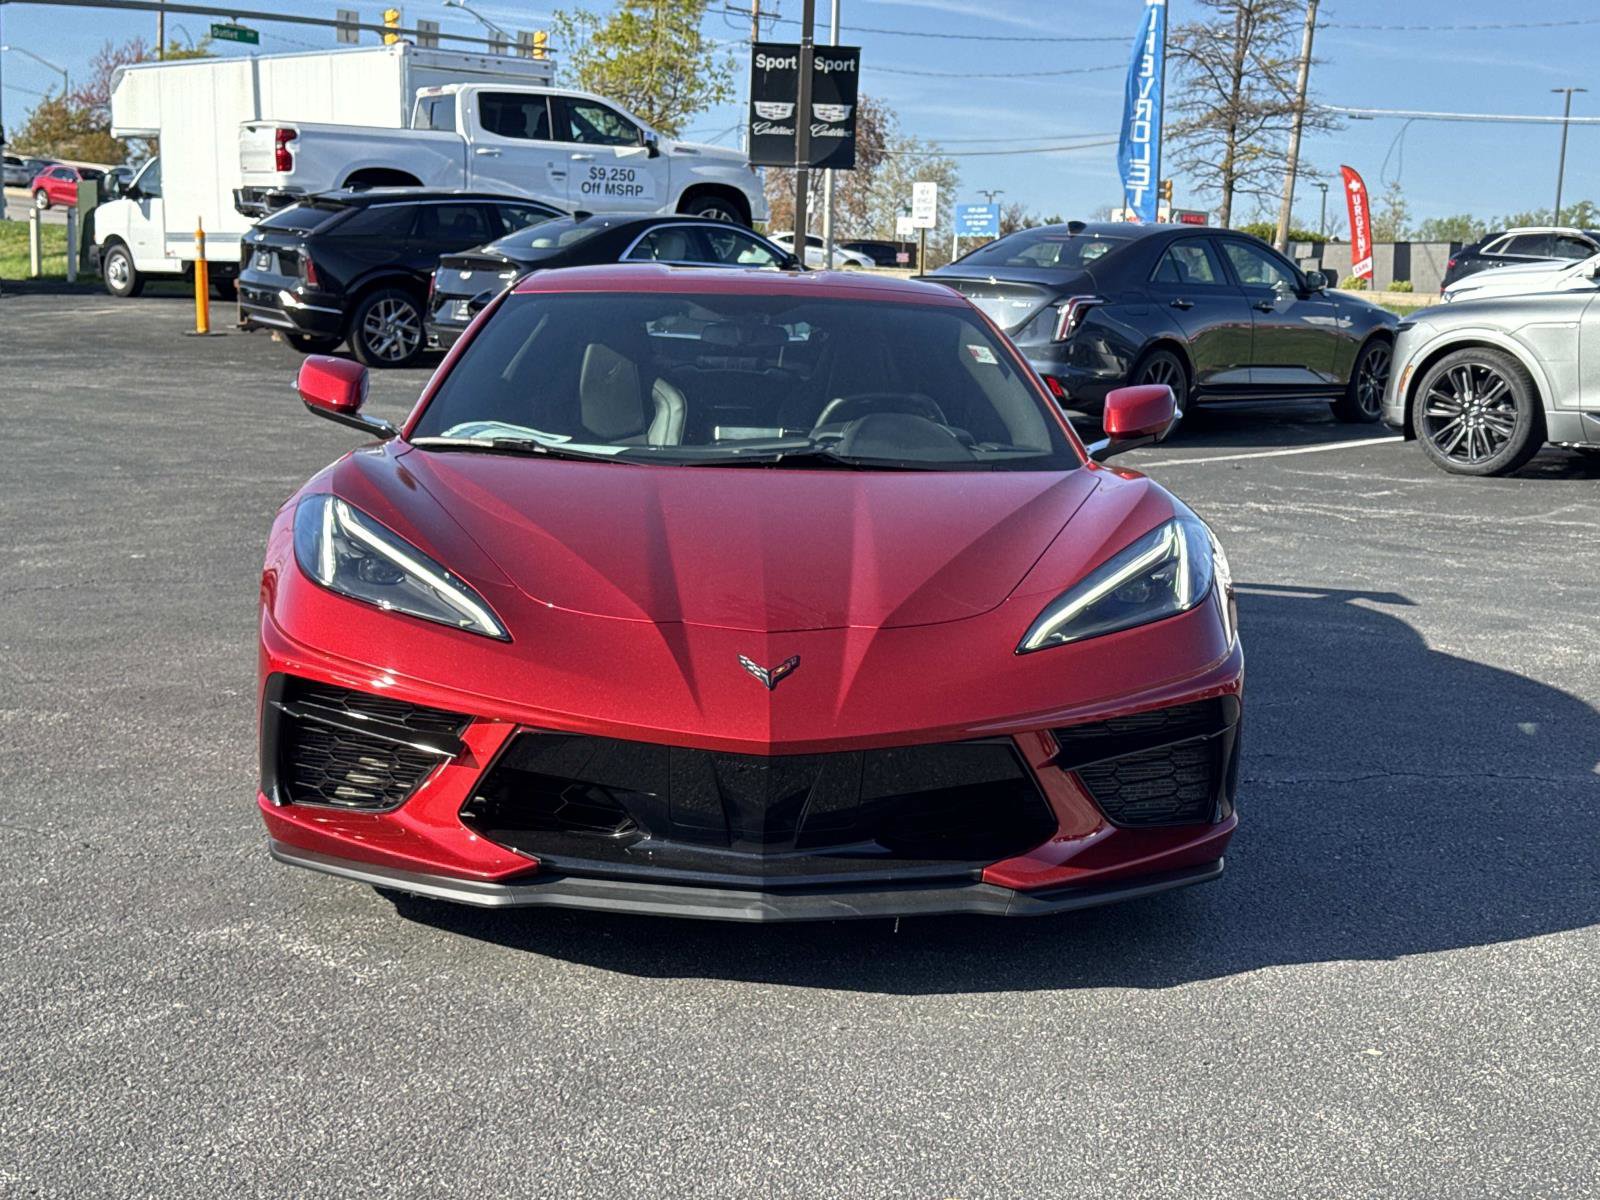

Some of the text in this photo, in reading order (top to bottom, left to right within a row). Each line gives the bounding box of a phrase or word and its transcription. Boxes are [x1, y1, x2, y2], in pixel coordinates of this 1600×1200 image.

[755, 53, 797, 72] Sport
[814, 56, 855, 74] Sport
[752, 121, 795, 136] Cadillac
[809, 123, 853, 137] Cadillac
[588, 166, 635, 183] $9,250
[581, 181, 644, 197] Off MSRP
[1352, 194, 1366, 260] URGENT
